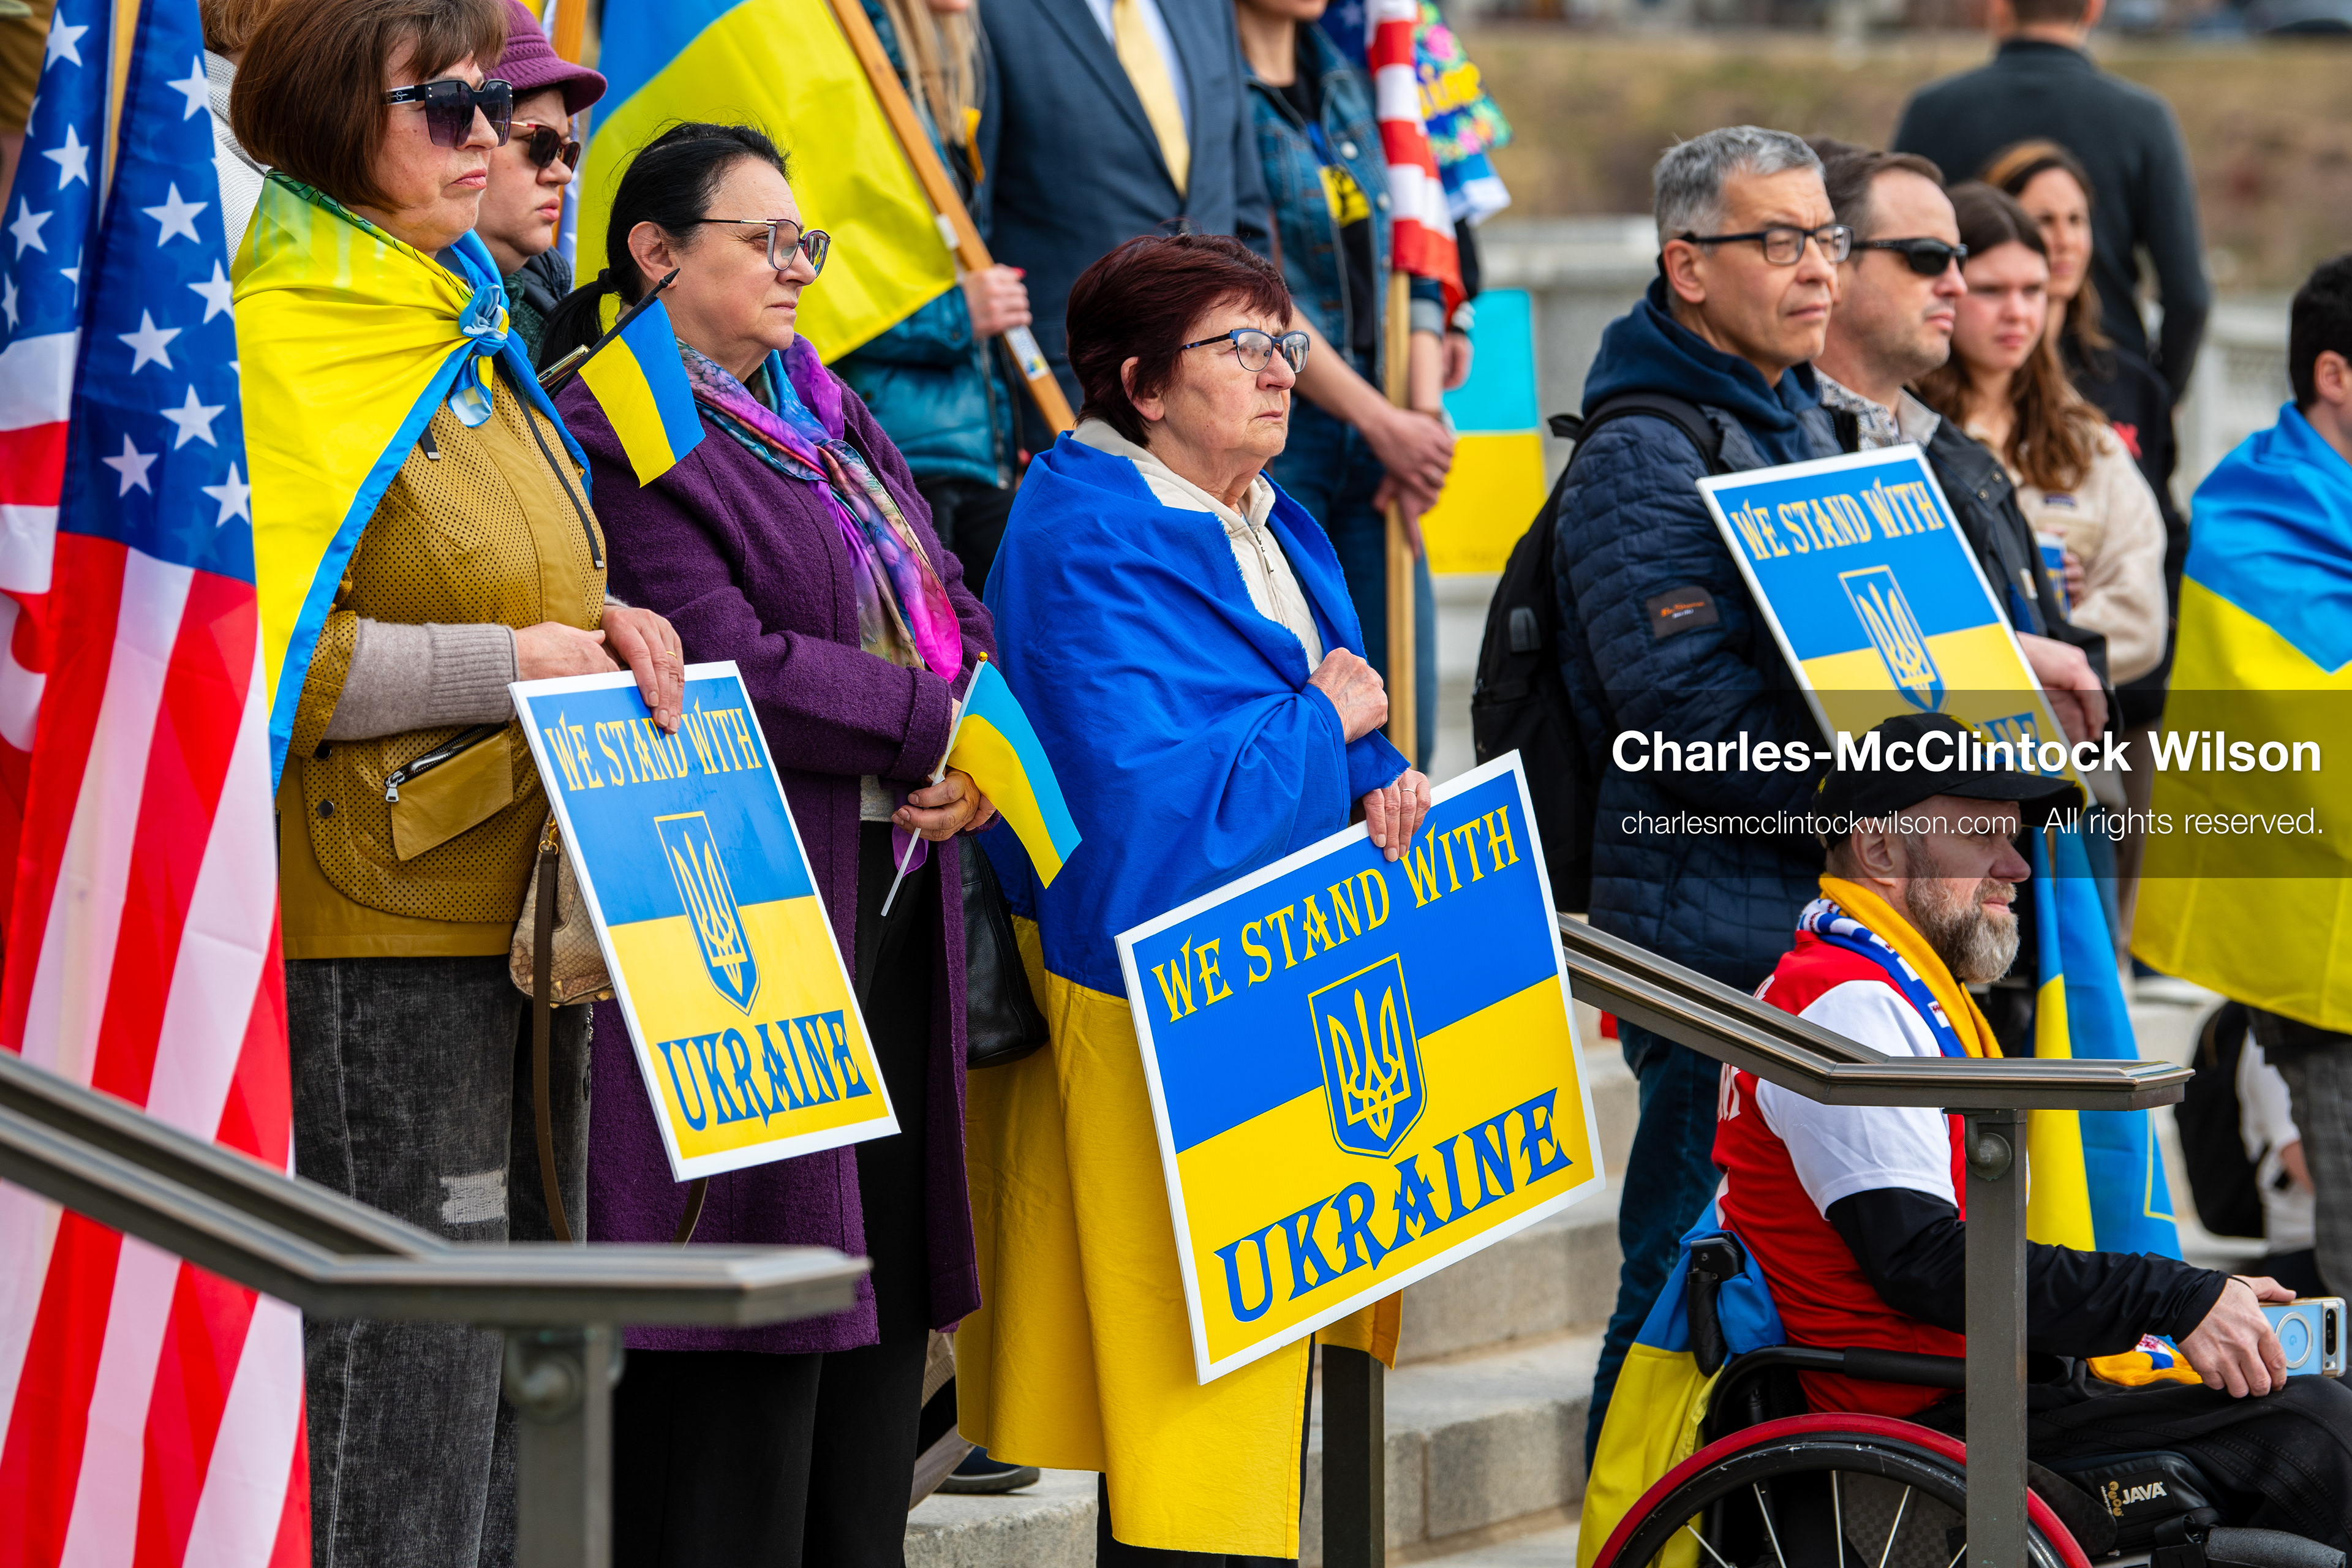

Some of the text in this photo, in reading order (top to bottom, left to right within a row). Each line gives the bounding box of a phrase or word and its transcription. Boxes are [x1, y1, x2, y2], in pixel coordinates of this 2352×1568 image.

[1730, 477, 1945, 560] WE STAND WITH
[545, 696, 763, 791] WE STAND WITH
[1152, 804, 1520, 1022] WE STAND WITH
[657, 1009, 873, 1131] UKRAINE
[1214, 1087, 1573, 1323] UKRAINE
[2122, 1482, 2168, 1505] JAVA
